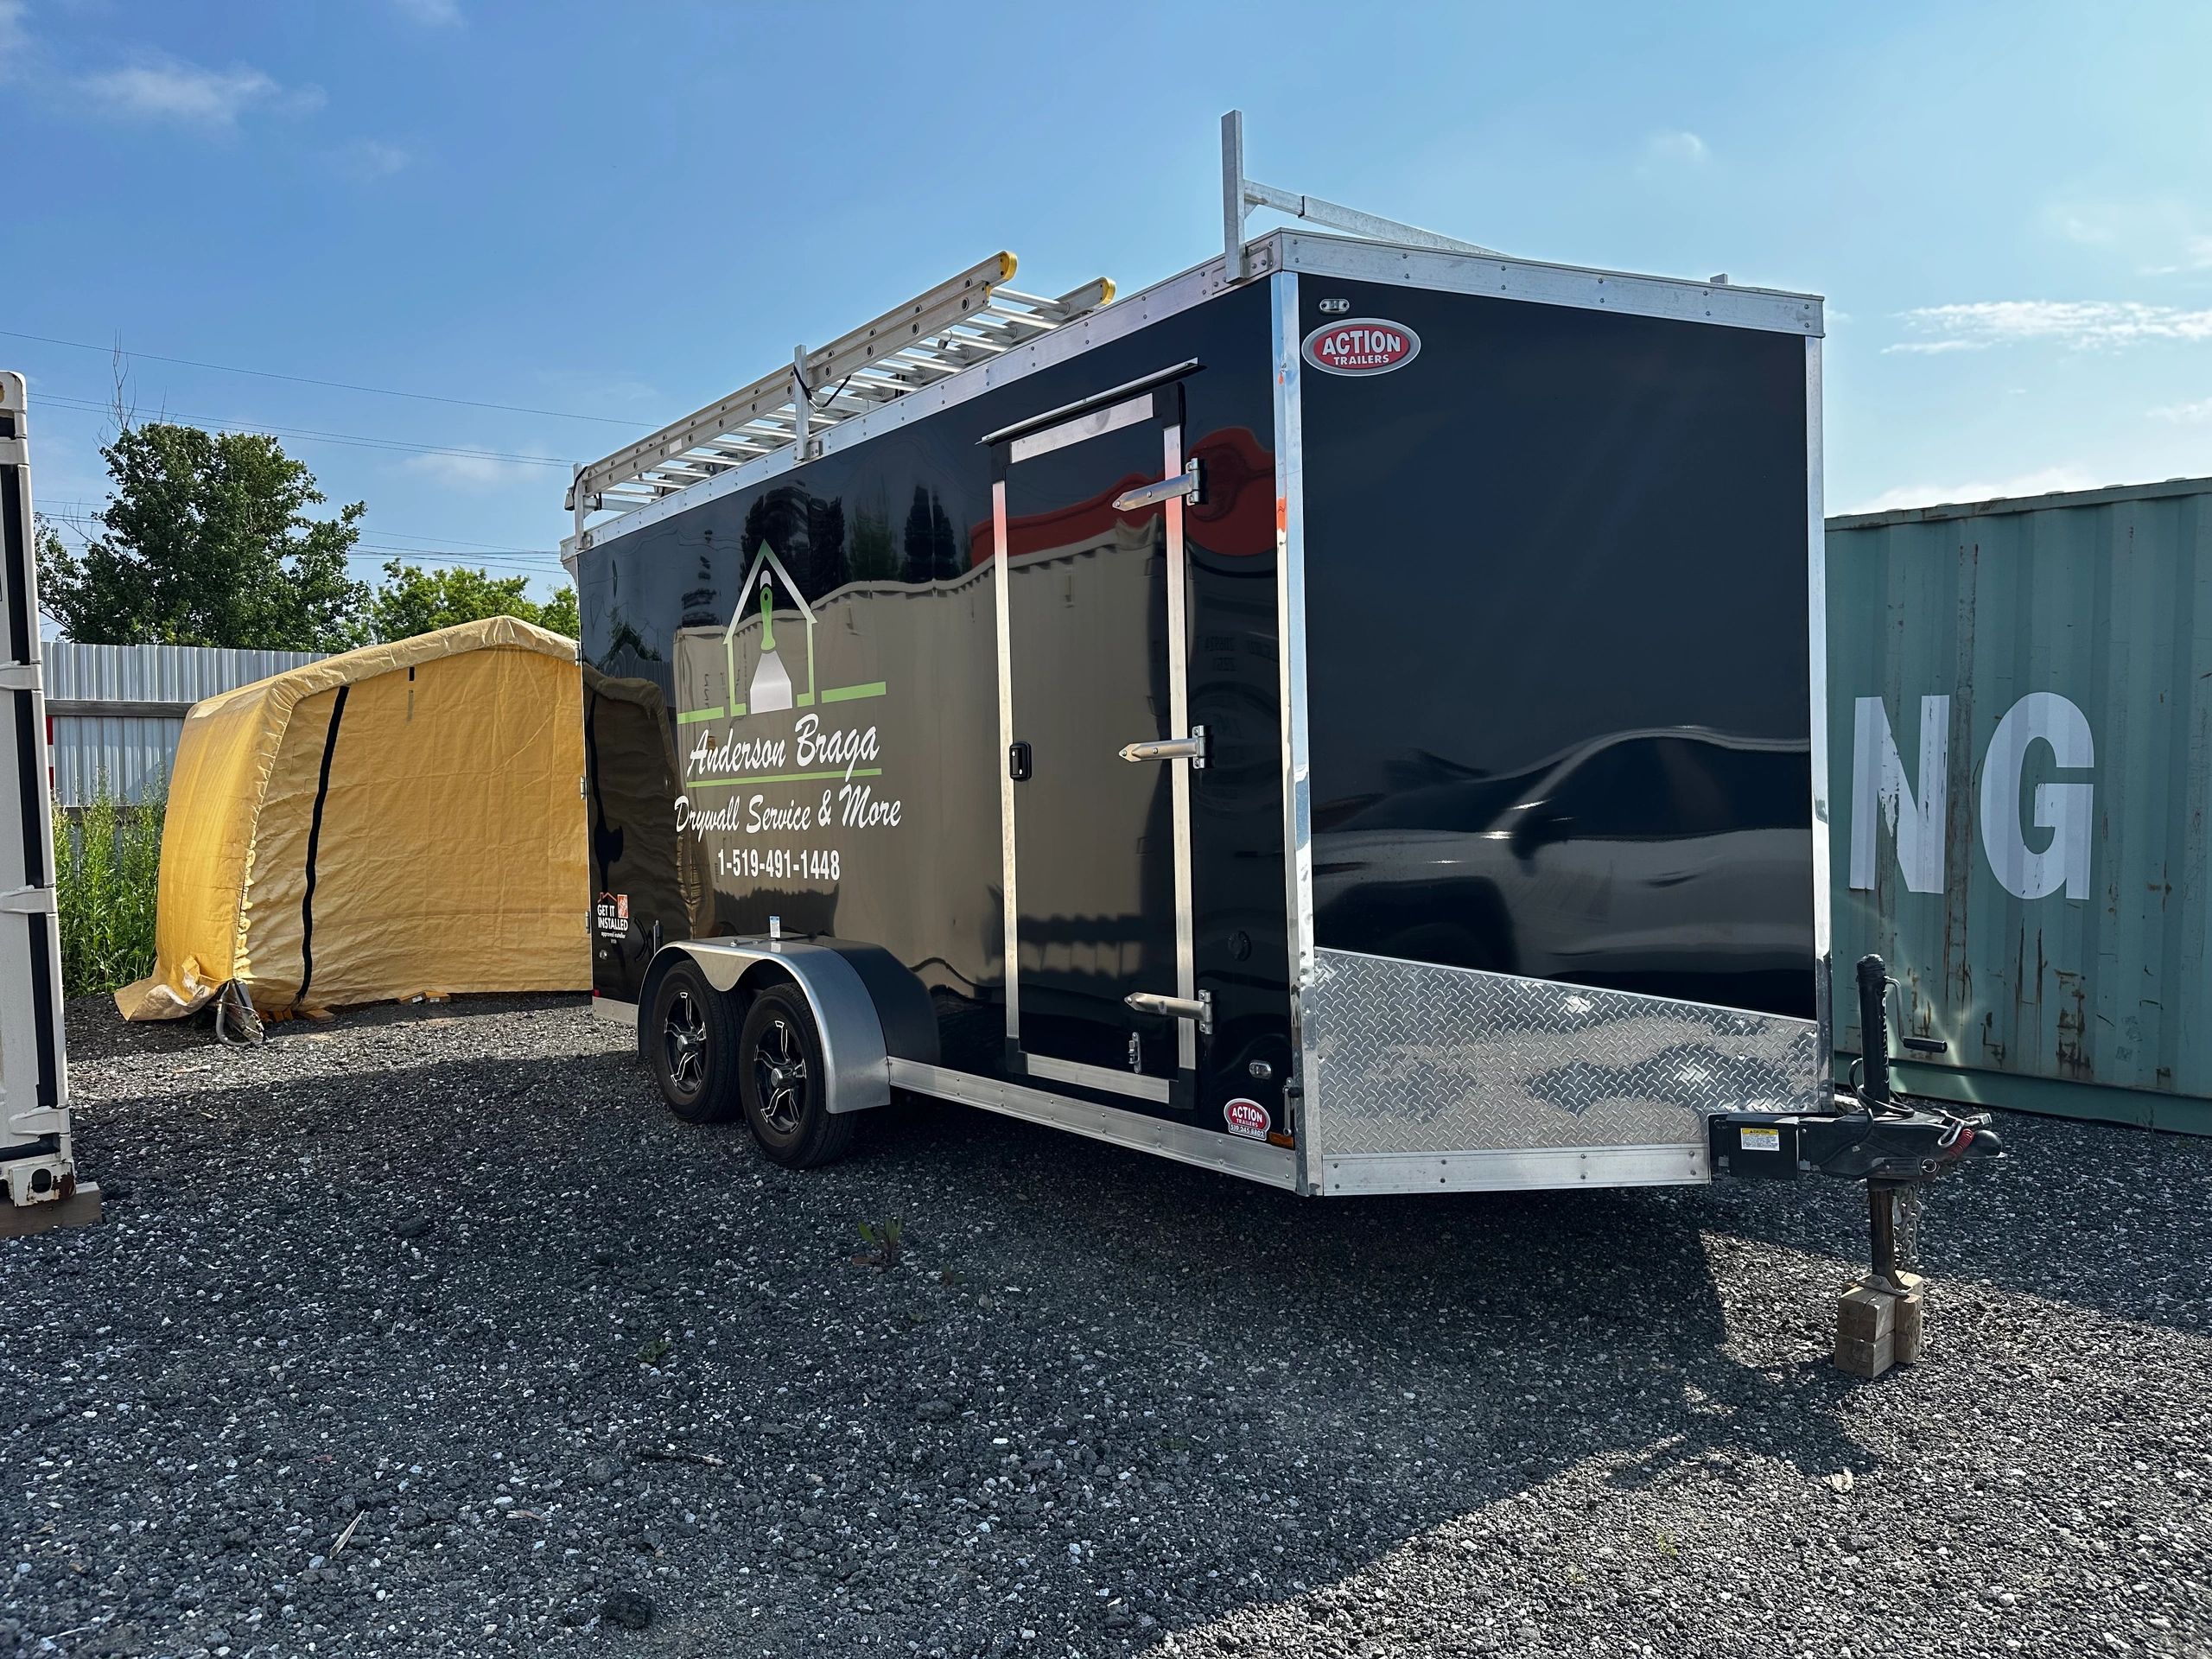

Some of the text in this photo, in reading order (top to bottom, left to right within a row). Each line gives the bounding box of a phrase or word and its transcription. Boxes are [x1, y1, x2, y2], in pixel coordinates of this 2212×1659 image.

[1321, 329, 1401, 356] ACTION
[1333, 353, 1389, 365] TRAILERS
[687, 713, 880, 782] Anderson Braga
[1849, 691, 2094, 900] NG
[674, 784, 902, 842] Drywall Service & More
[718, 849, 841, 880] 1-519-491-1448
[597, 904, 615, 918] GET IT
[597, 917, 628, 931] INSTALLED
[1232, 1106, 1262, 1123] ACTION
[1236, 1118, 1258, 1128] TRAILERS
